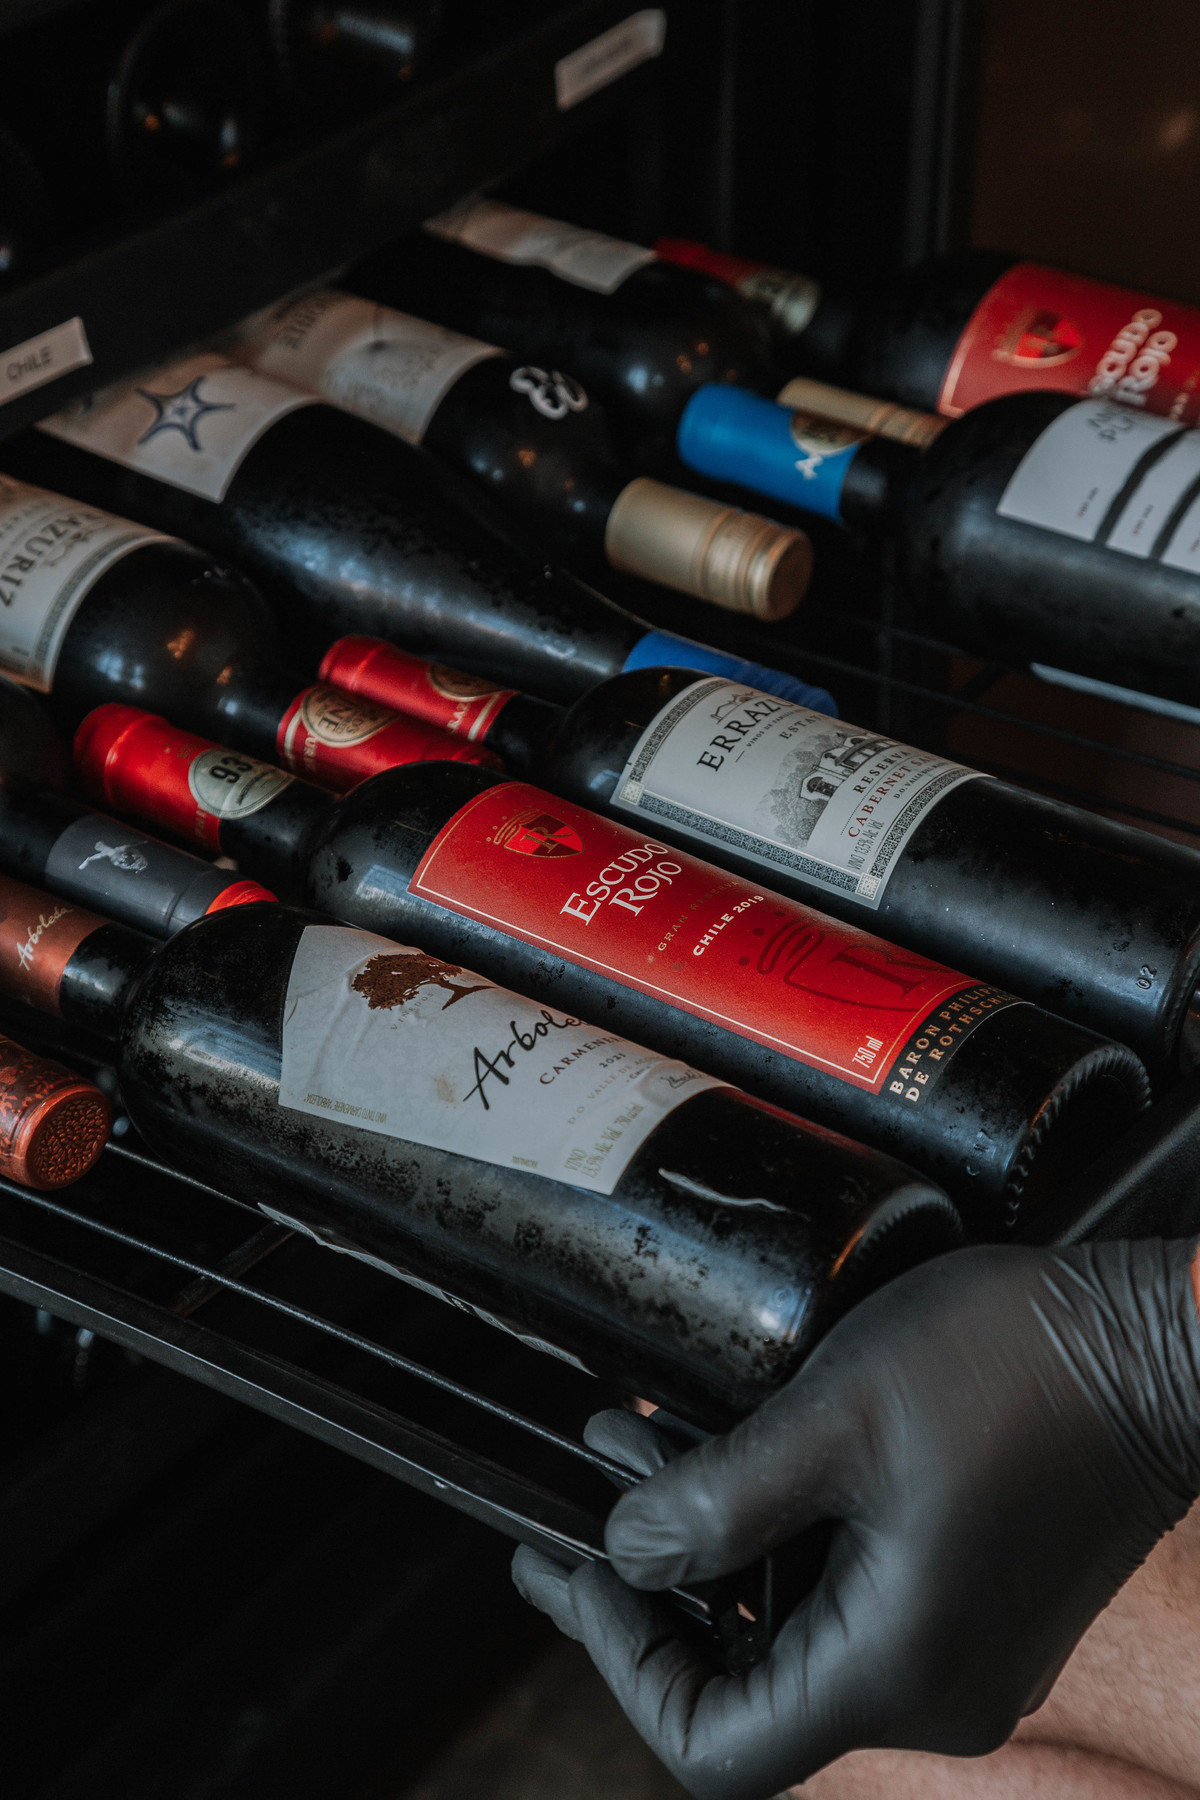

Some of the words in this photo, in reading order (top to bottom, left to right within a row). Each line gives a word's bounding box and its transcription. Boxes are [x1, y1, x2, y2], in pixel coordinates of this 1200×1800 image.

[209, 757, 254, 783] 93
[853, 750, 911, 793] RESERVA
[848, 764, 912, 838] CABERNET
[559, 843, 669, 926] ESCUDO
[609, 861, 683, 917] ROJO
[657, 914, 689, 952] GRAN
[692, 912, 736, 957] CHILE
[732, 895, 766, 914] 2019
[598, 1052, 628, 1069] 2021
[851, 1045, 877, 1069] 750
[865, 1035, 884, 1052] ml
[889, 1023, 942, 1095] BARON
[904, 1070, 930, 1103] DE
